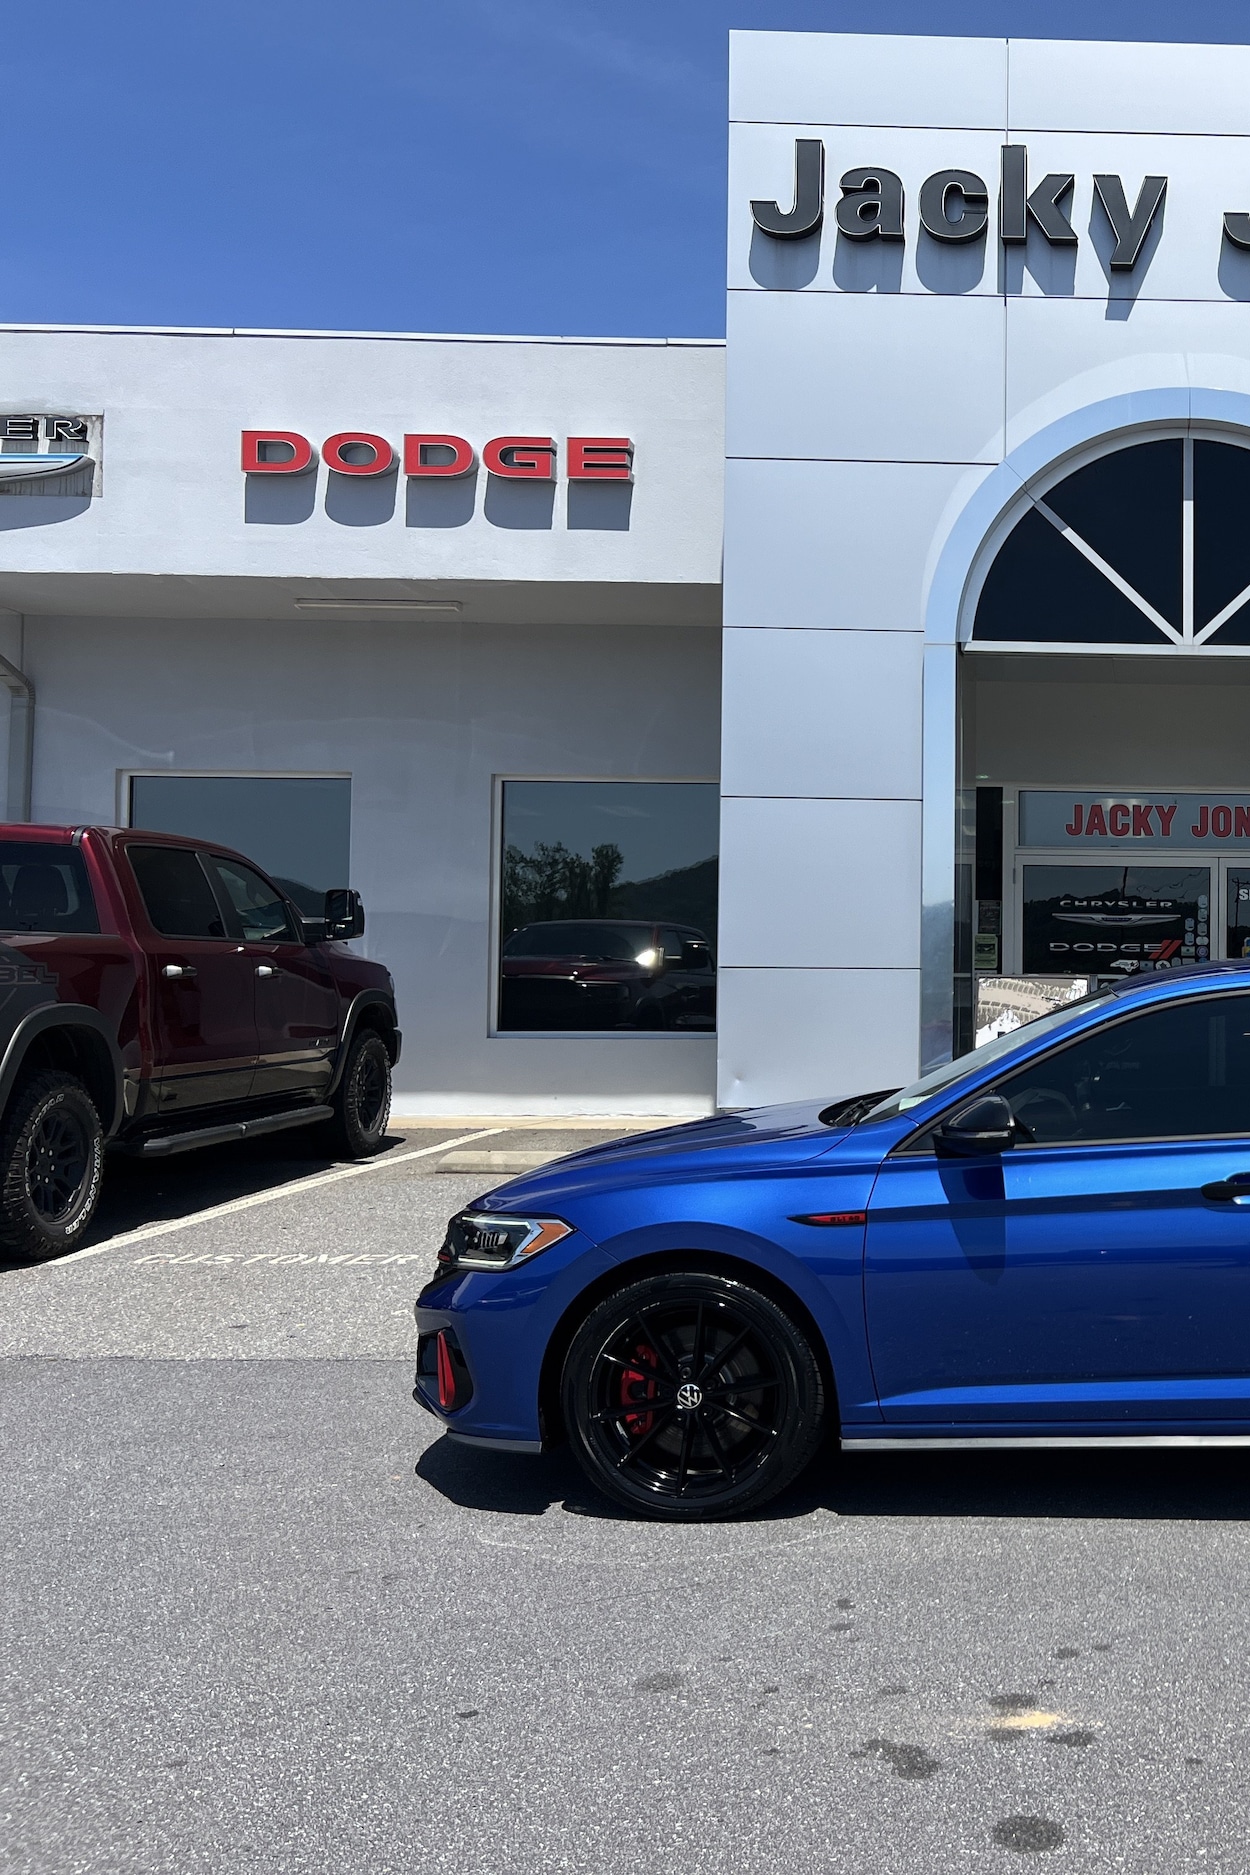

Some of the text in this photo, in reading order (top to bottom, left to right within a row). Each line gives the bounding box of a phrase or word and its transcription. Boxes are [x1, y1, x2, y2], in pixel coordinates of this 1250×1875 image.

[749, 138, 1170, 272] Jacky
[240, 430, 635, 484] DODGE
[1065, 803, 1178, 838] JACKY
[1059, 899, 1173, 909] CHRYSLER
[1049, 942, 1163, 953] DODGE
[64, 1136, 102, 1235] WRANGLER
[133, 1253, 420, 1266] CUSTOMER
